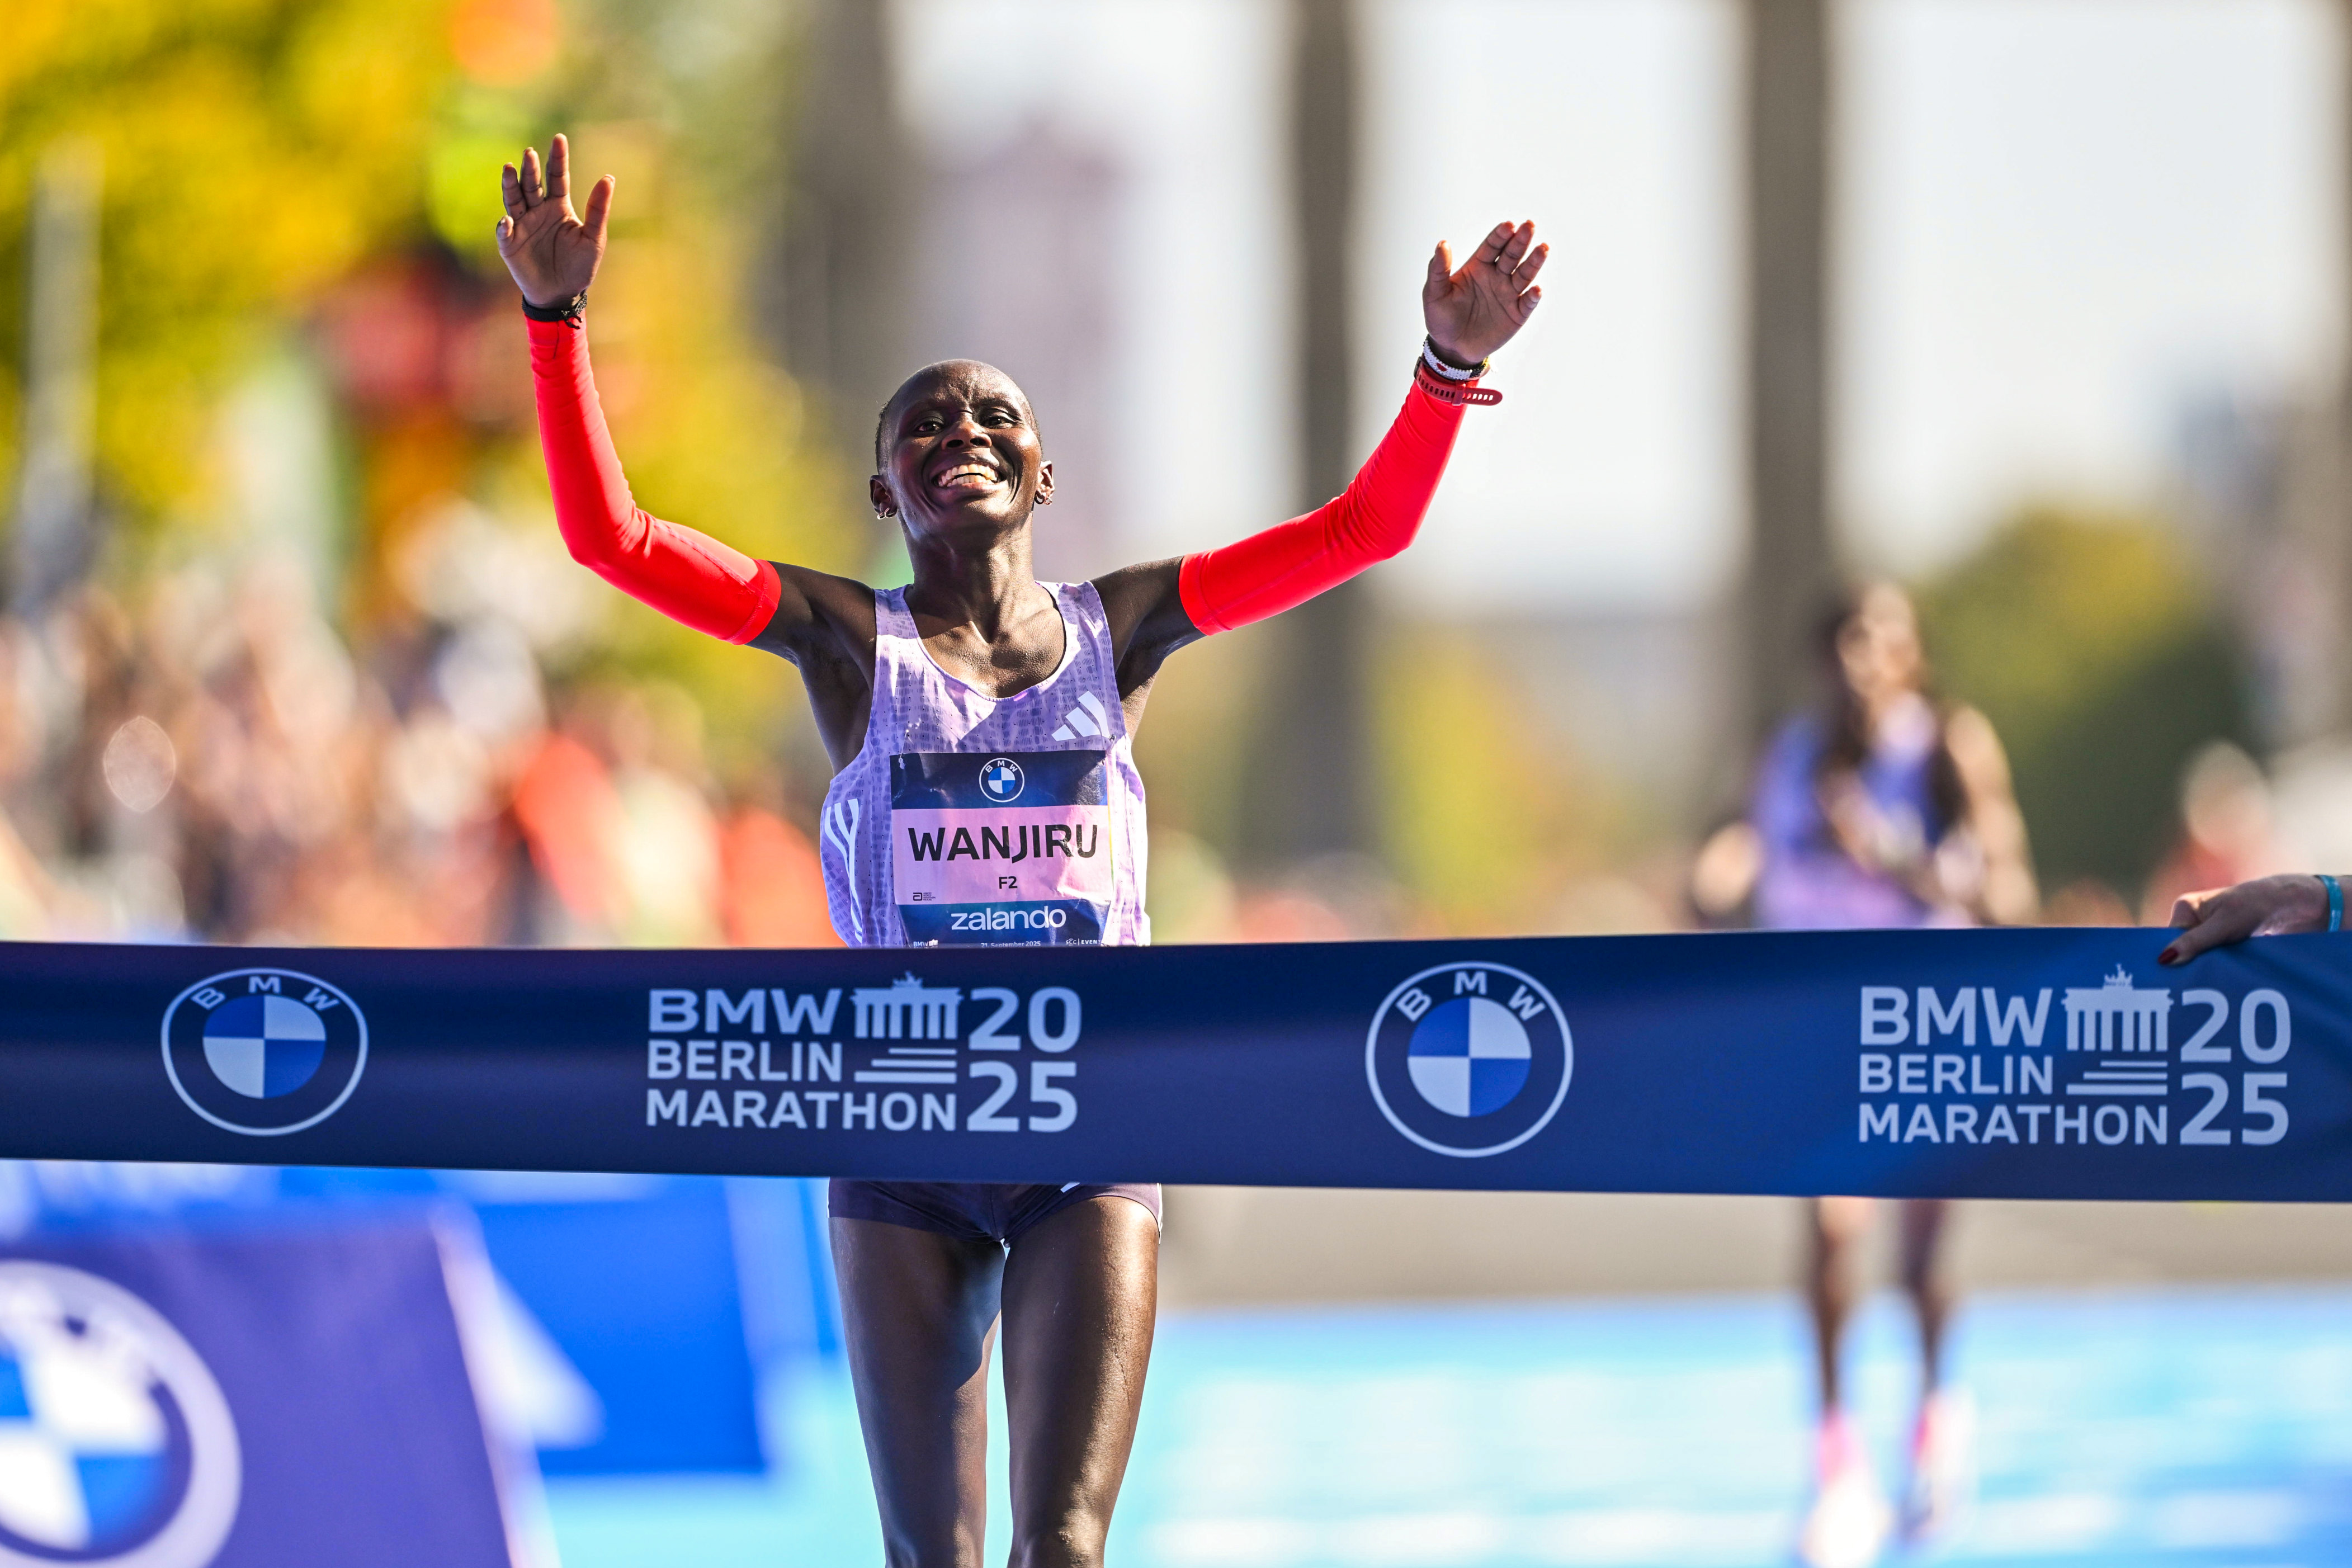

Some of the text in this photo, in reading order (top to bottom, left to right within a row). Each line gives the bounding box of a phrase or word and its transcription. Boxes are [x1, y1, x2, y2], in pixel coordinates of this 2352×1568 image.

[985, 760, 1018, 773] BMW
[908, 824, 1098, 863] WANJIRU
[999, 876, 1018, 889] F2
[951, 905, 1066, 931] zalando
[191, 976, 339, 1010] BMW
[649, 988, 842, 1035] BMW
[1396, 971, 1545, 1022] BMW
[968, 987, 1081, 1053] 20
[1860, 986, 2053, 1047] BMW
[2180, 988, 2291, 1064] 20
[647, 1040, 842, 1082] BERLIN
[1859, 1053, 2053, 1094] BERLIN
[646, 1089, 956, 1131] MARATHON
[967, 1061, 1078, 1132] 25
[2180, 1072, 2289, 1145] 25
[1859, 1103, 2167, 1145] MARATHON
